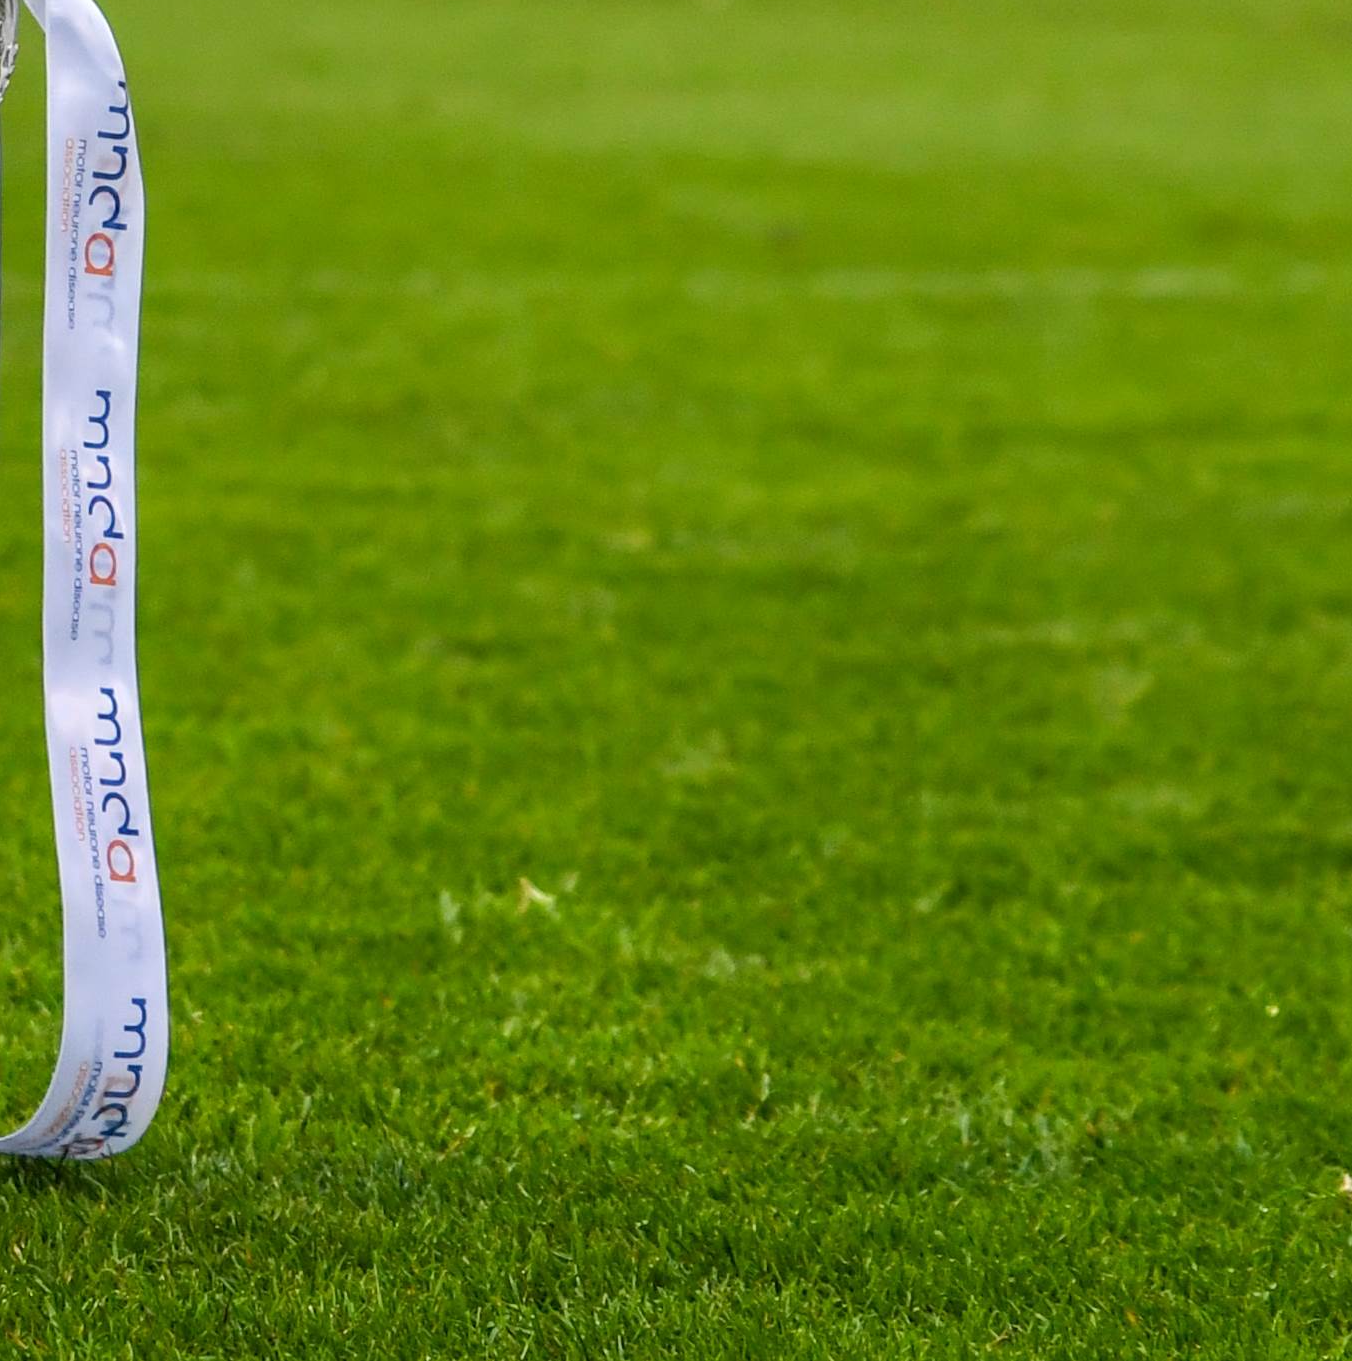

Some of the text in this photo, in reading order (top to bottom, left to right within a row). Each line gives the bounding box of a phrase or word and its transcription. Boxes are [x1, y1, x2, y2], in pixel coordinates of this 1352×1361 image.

[60, 138, 74, 232] association
[68, 139, 86, 330] motor neurone disease
[84, 81, 130, 277] mnda
[60, 449, 72, 543] association
[70, 449, 83, 640] motor neurone disease
[82, 390, 124, 586] mnda
[69, 746, 86, 842] association
[79, 747, 107, 938] motor neurone disease
[94, 687, 138, 883] mnda
